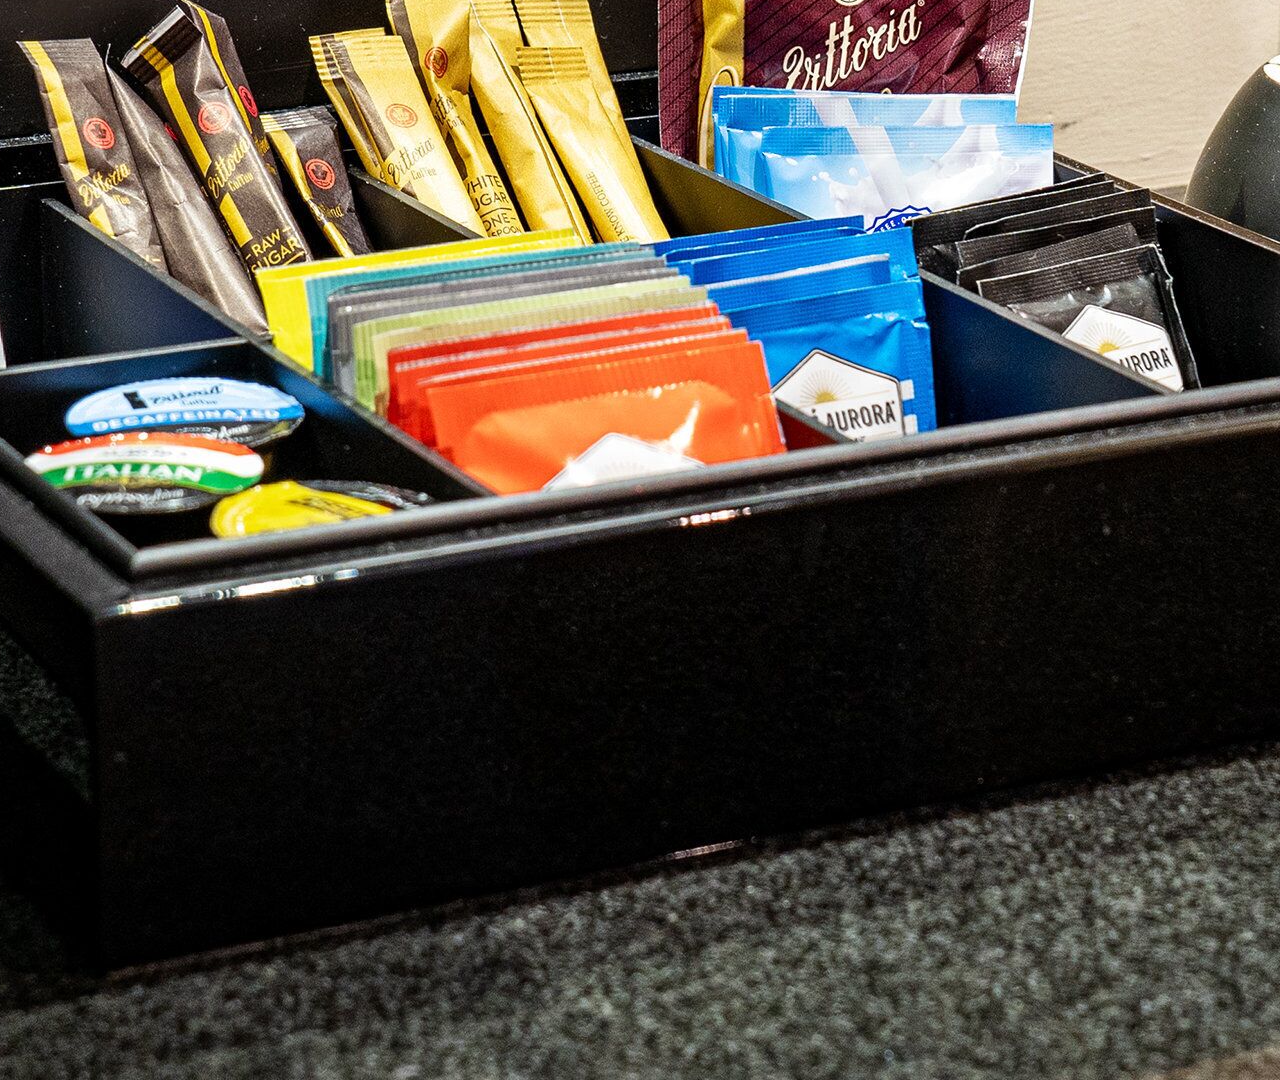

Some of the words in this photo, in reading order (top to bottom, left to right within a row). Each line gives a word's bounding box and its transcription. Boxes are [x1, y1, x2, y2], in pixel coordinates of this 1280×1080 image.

[782, 3, 922, 92] Vittoria
[207, 138, 250, 199] Vittoria
[387, 139, 435, 185] Vittoria
[473, 190, 509, 212] UGAR
[585, 171, 610, 207] COFFEE
[603, 207, 626, 237] KNOW
[250, 228, 281, 257] RAW
[91, 408, 280, 432] DECAFFEINATED
[826, 400, 897, 432] AURORA
[63, 463, 202, 483] ITALIAN
